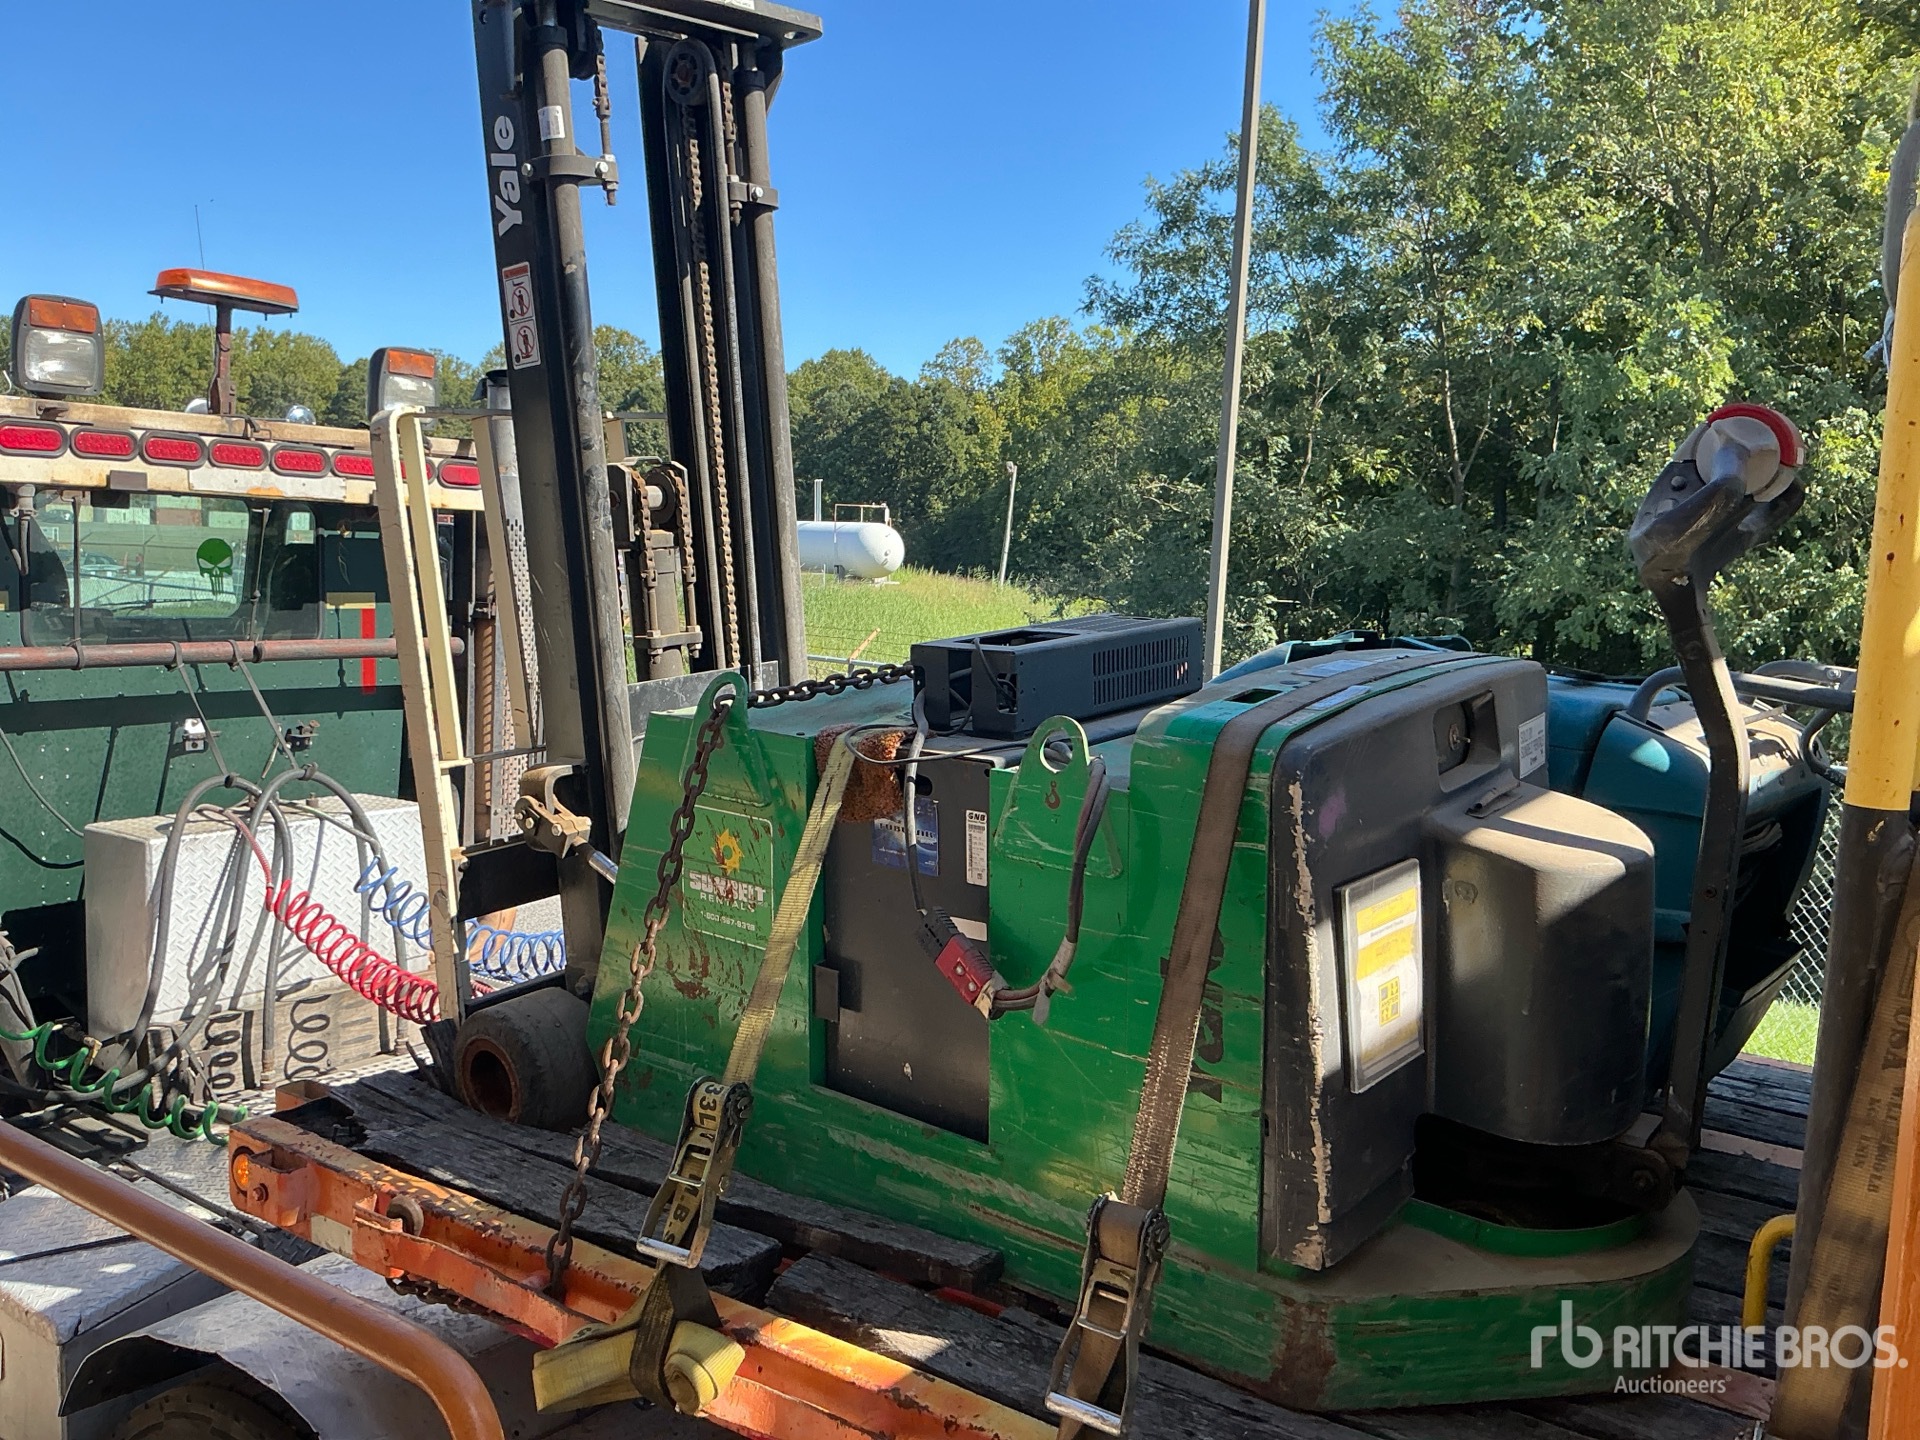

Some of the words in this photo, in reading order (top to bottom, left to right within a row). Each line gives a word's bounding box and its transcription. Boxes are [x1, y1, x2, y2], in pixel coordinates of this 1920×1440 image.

[490, 115, 523, 237] Yale
[968, 812, 986, 821] GNB
[689, 871, 766, 902] SUNBELT
[700, 892, 755, 912] RENTALS
